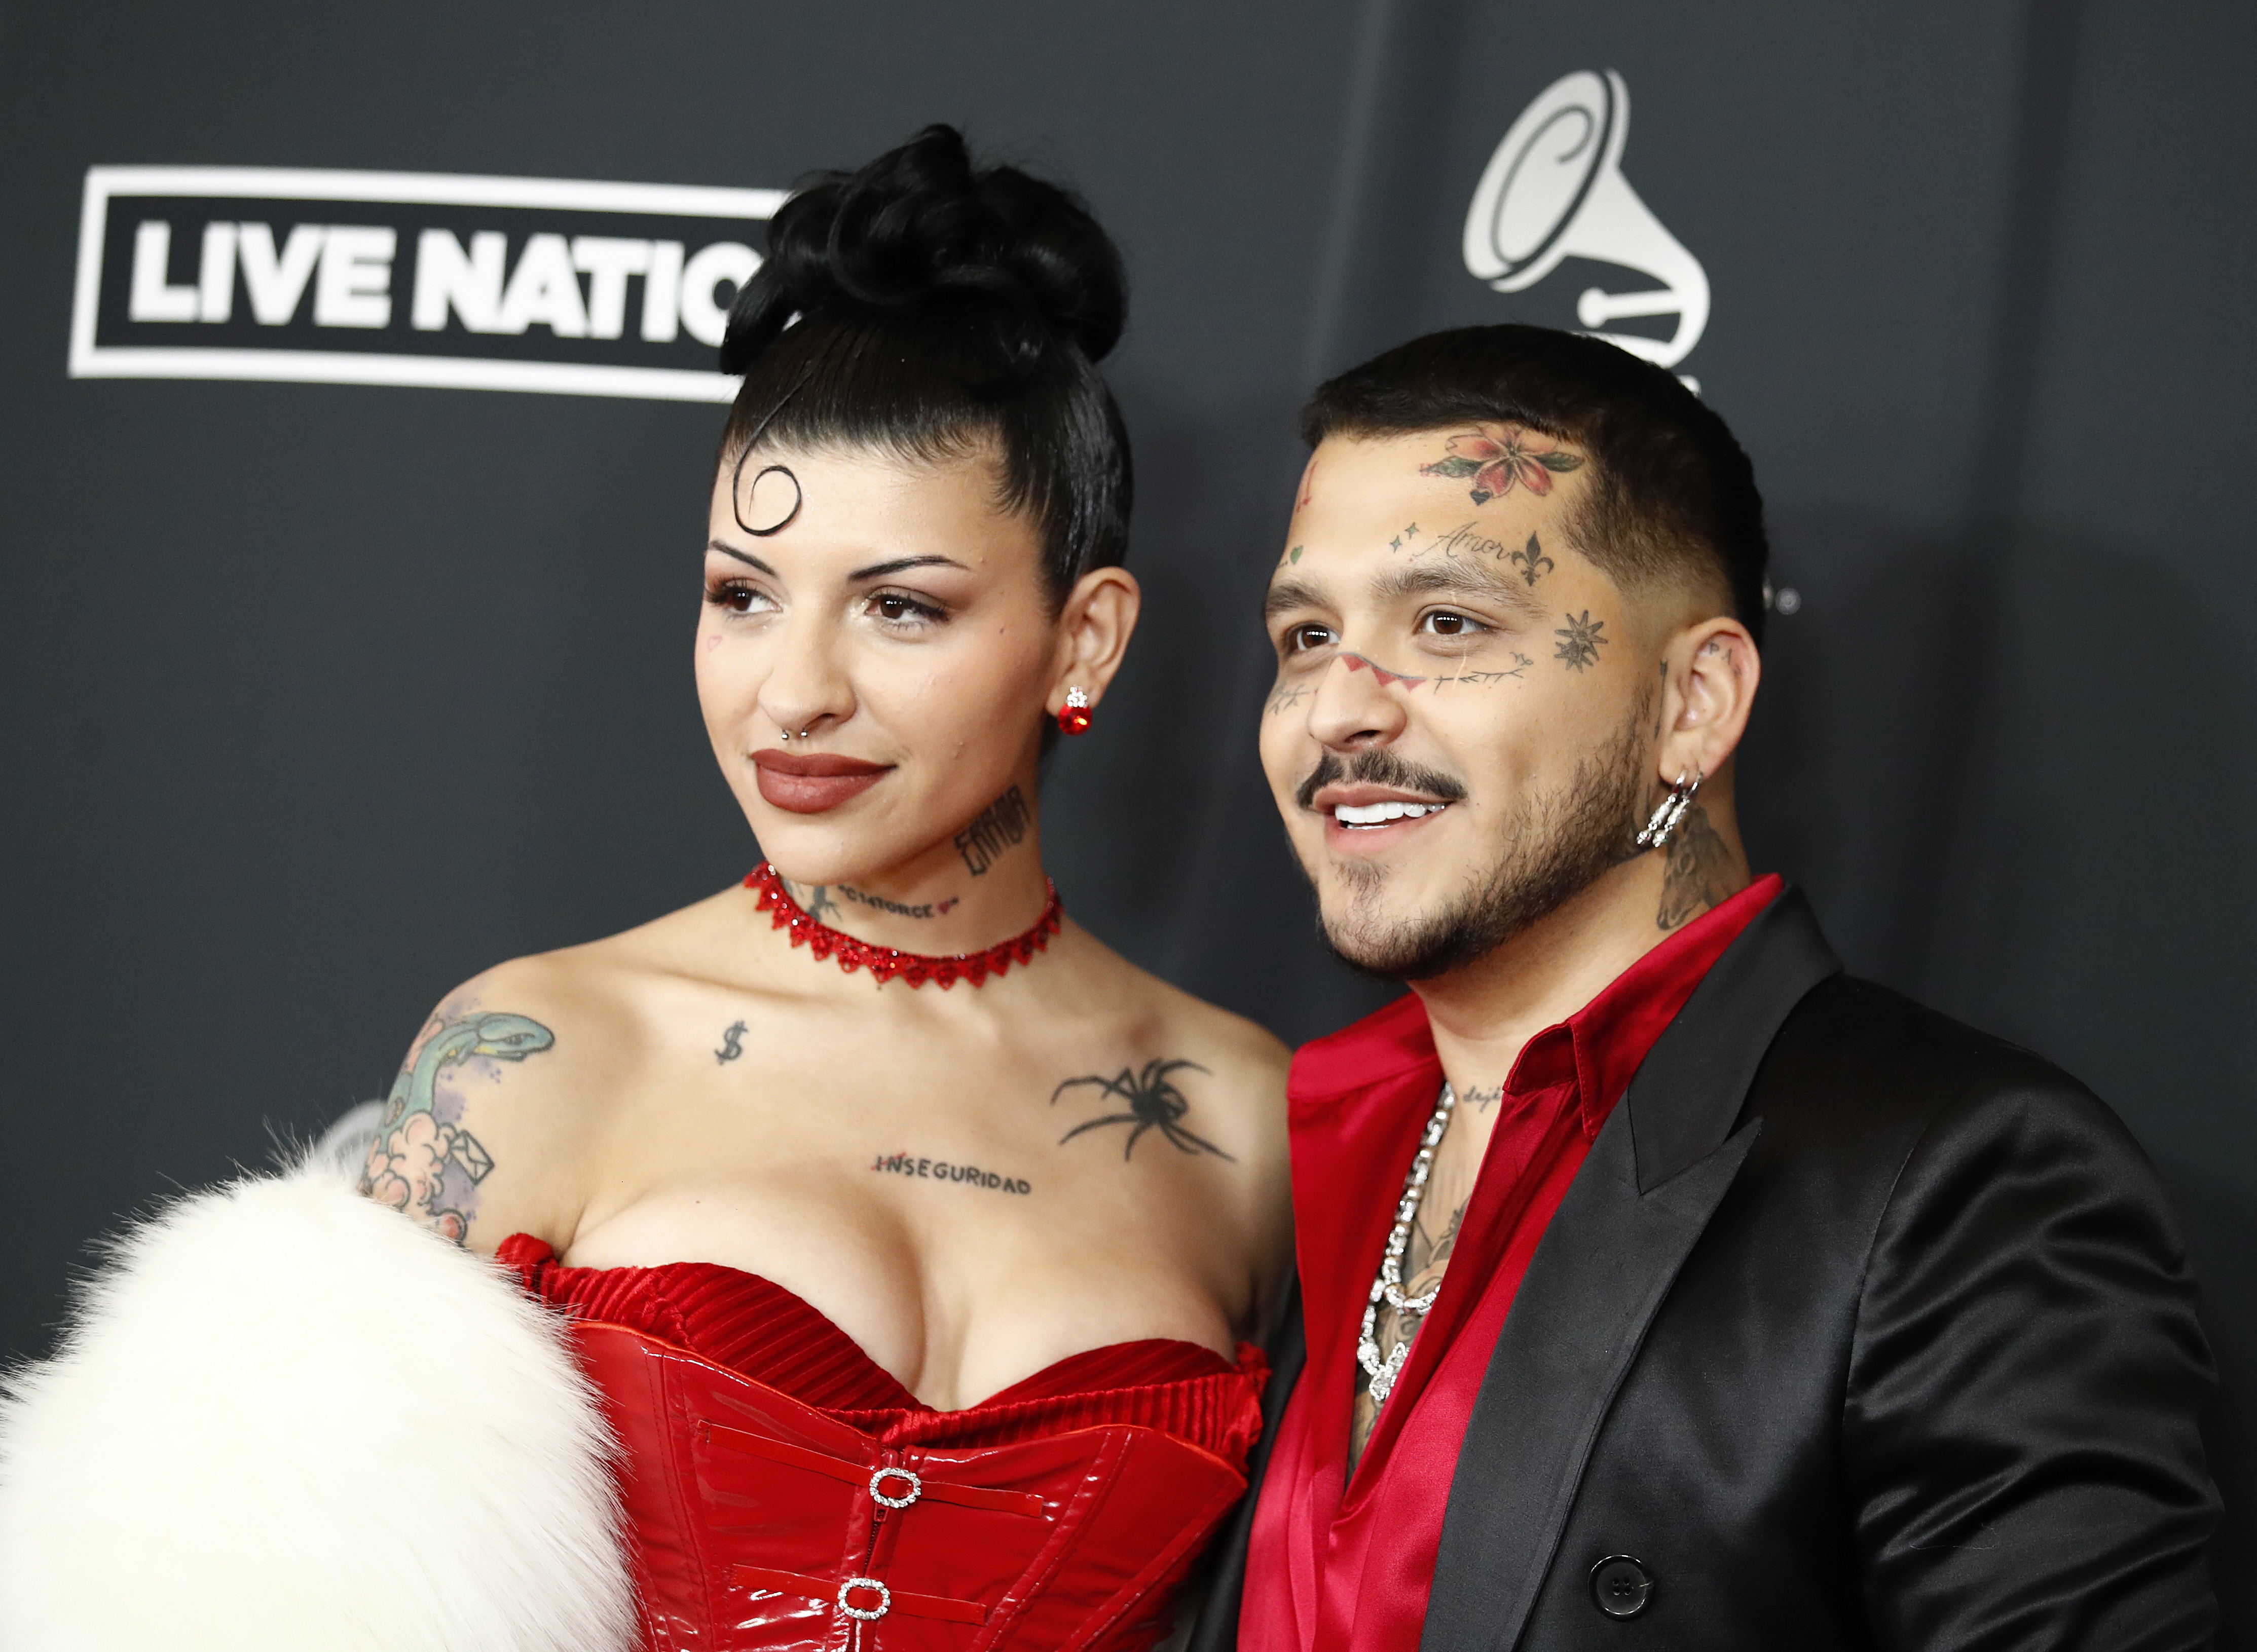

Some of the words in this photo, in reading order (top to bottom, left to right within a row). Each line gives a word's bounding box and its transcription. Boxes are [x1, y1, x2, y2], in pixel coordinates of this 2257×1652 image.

[129, 220, 396, 328] LIVE
[411, 228, 764, 348] NATIO
[1412, 521, 1510, 559] Amor
[874, 1154, 1032, 1195] INSEGURIDAD
